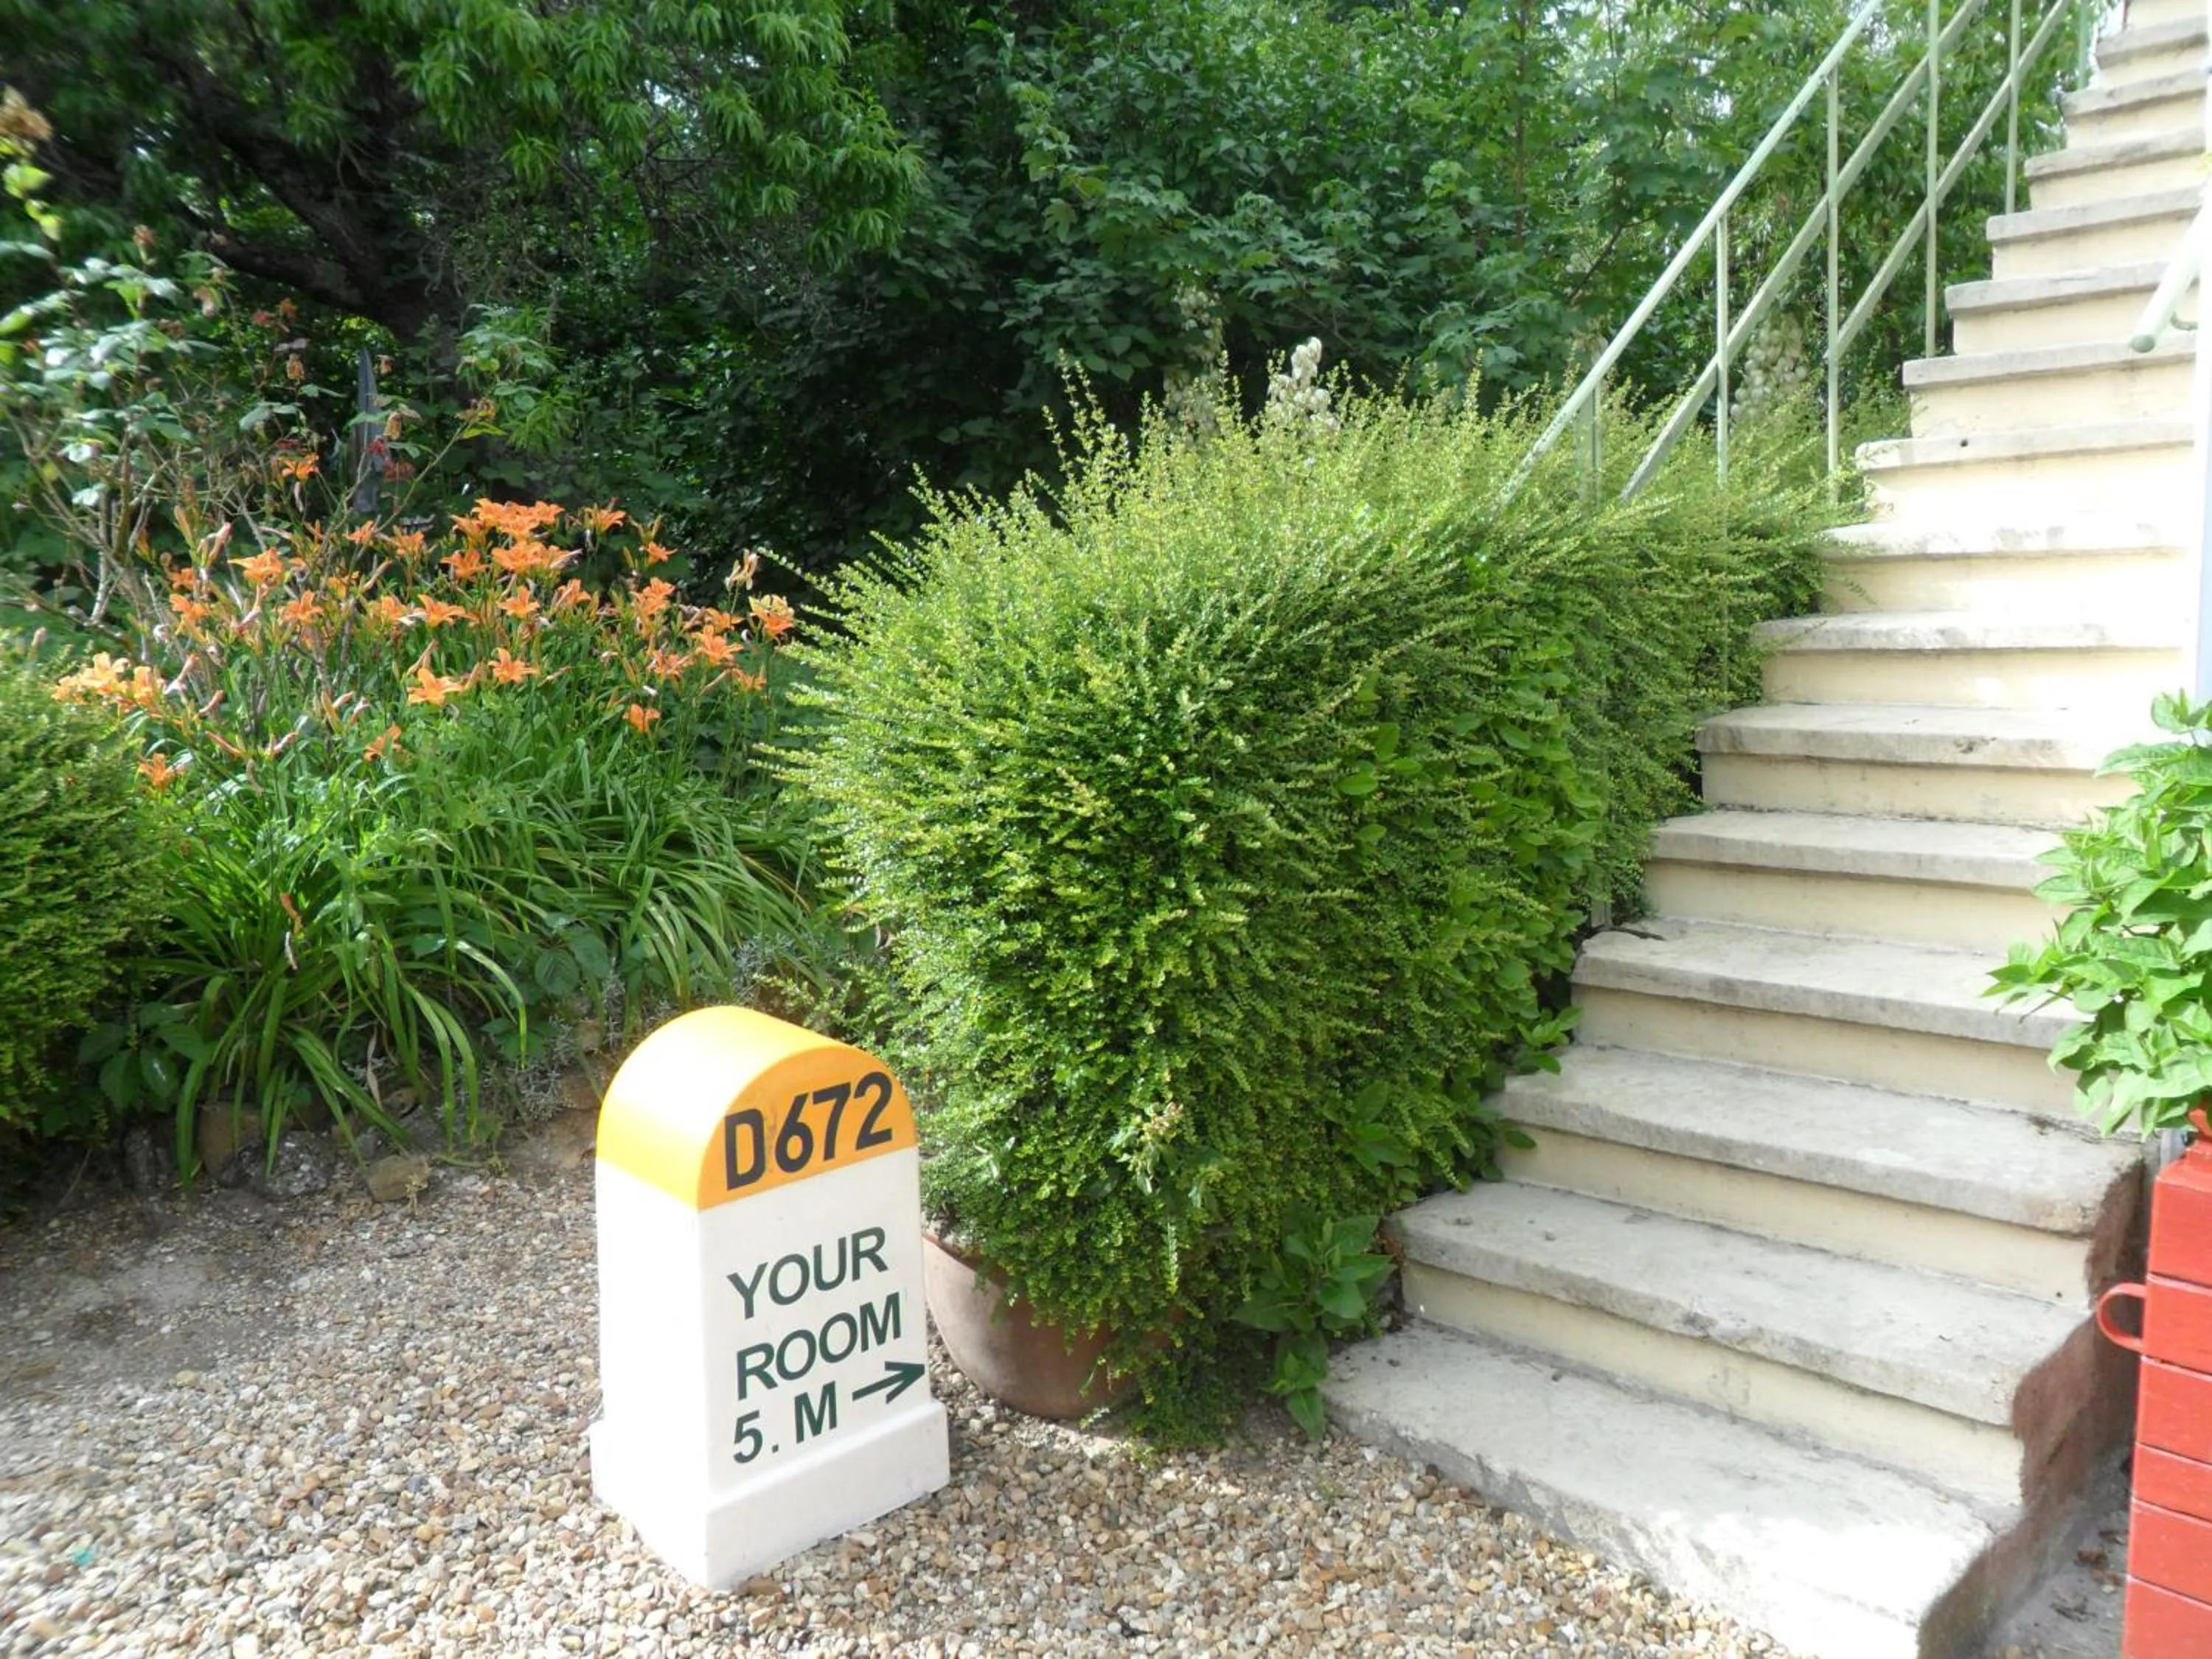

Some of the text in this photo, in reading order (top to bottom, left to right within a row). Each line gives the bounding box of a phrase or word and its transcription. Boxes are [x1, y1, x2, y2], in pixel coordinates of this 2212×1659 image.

[724, 1071, 893, 1190] D672
[727, 1226, 888, 1319] YOUR
[737, 1292, 901, 1400] ROOM
